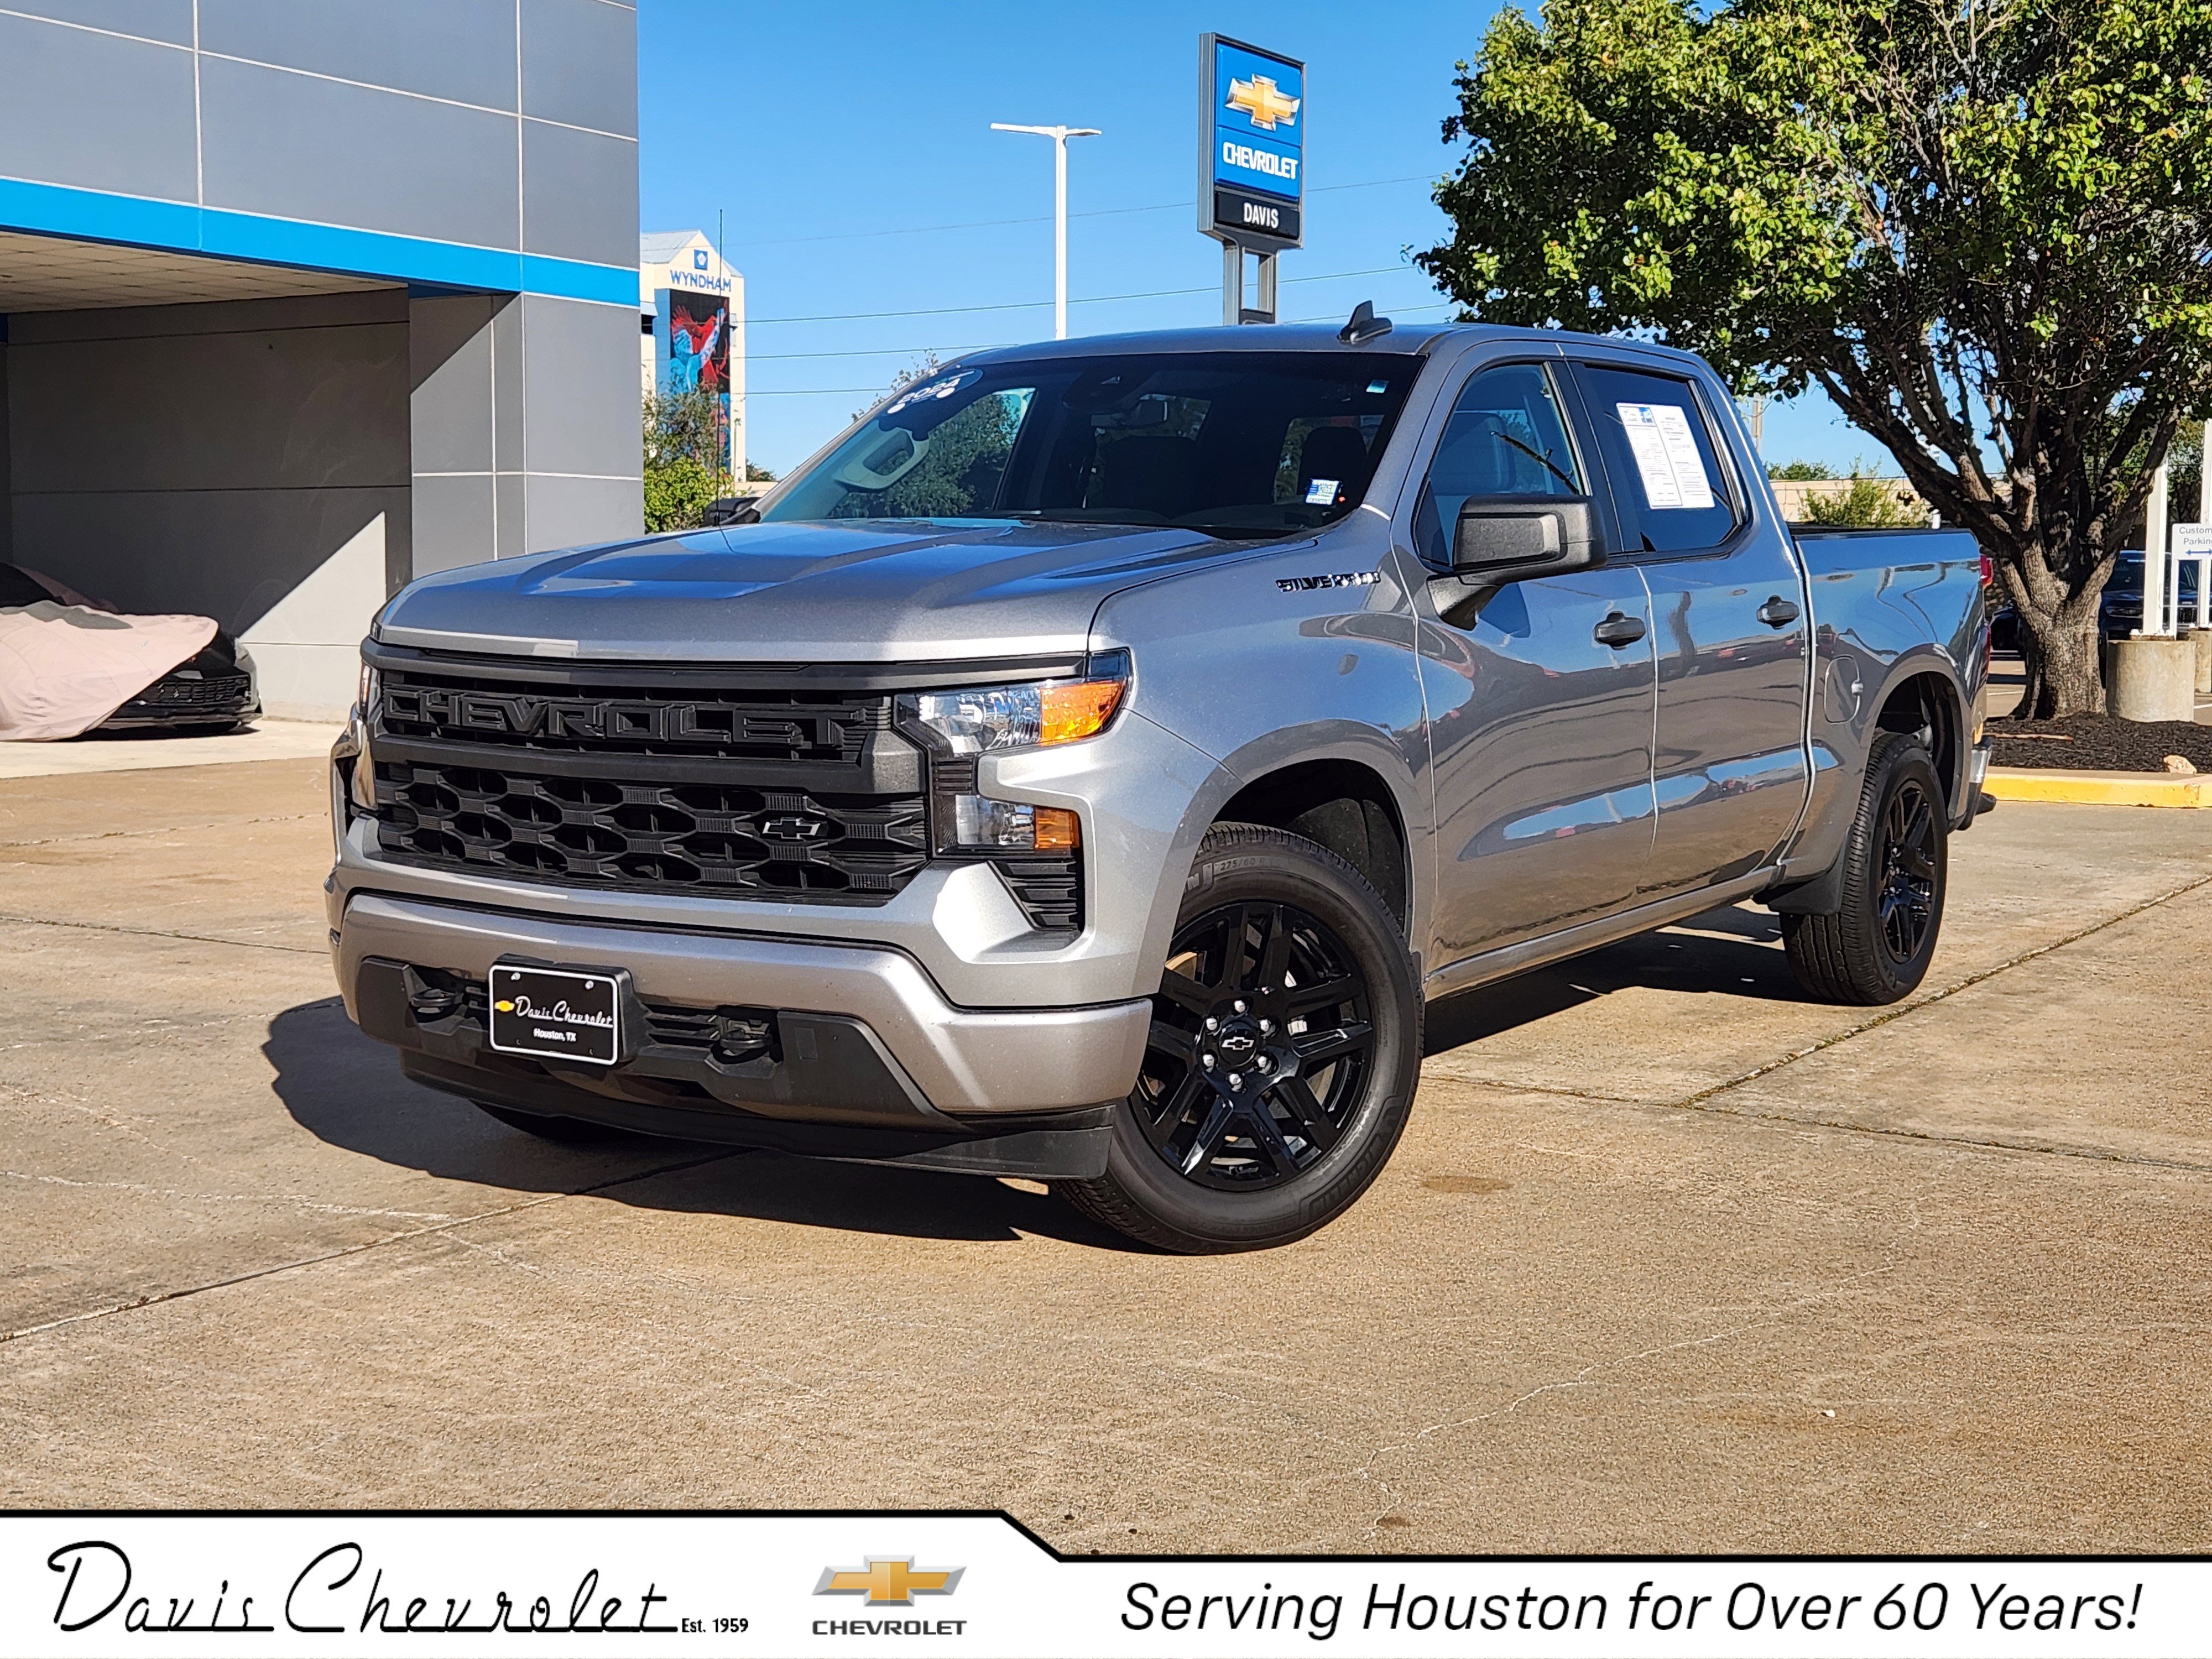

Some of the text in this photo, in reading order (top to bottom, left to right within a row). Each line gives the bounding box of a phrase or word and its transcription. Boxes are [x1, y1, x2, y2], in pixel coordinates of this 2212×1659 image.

[1223, 142, 1298, 180] CHEVROLET
[1244, 202, 1279, 229] DAVIS
[670, 269, 732, 293] WYNDHAM
[898, 378, 961, 404] 2024
[2183, 537, 2212, 545] Parkin
[383, 689, 865, 748] CHEVROLET
[515, 995, 614, 1028] Davis Chevrolet
[533, 1027, 577, 1042] Houston, TX
